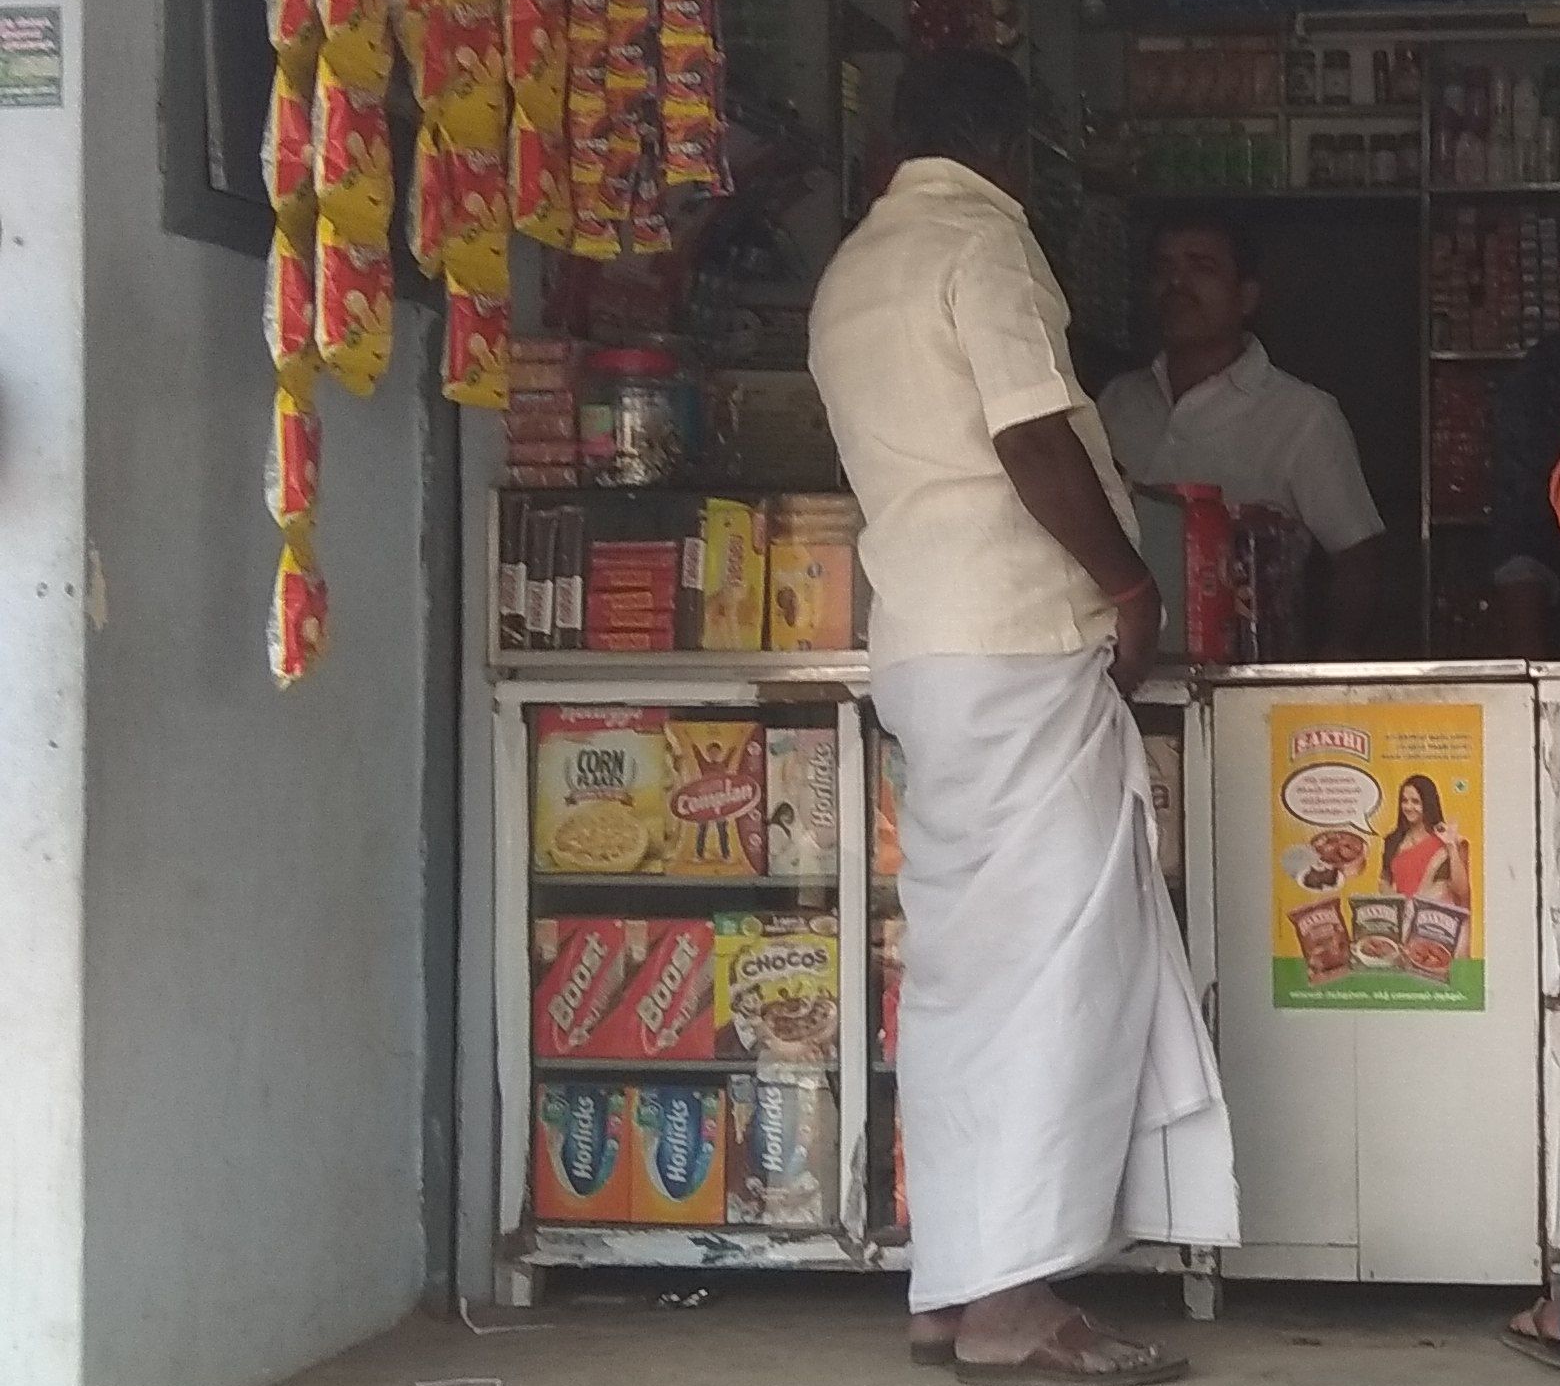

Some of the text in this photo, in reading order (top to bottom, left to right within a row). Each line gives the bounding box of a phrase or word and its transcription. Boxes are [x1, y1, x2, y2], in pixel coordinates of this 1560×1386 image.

[576, 748, 625, 775] CORN
[740, 946, 828, 978] CHOCOS
[572, 1094, 596, 1180] Horlicks
[666, 1097, 690, 1183] Horlicks
[762, 1086, 783, 1173] Horlicks
